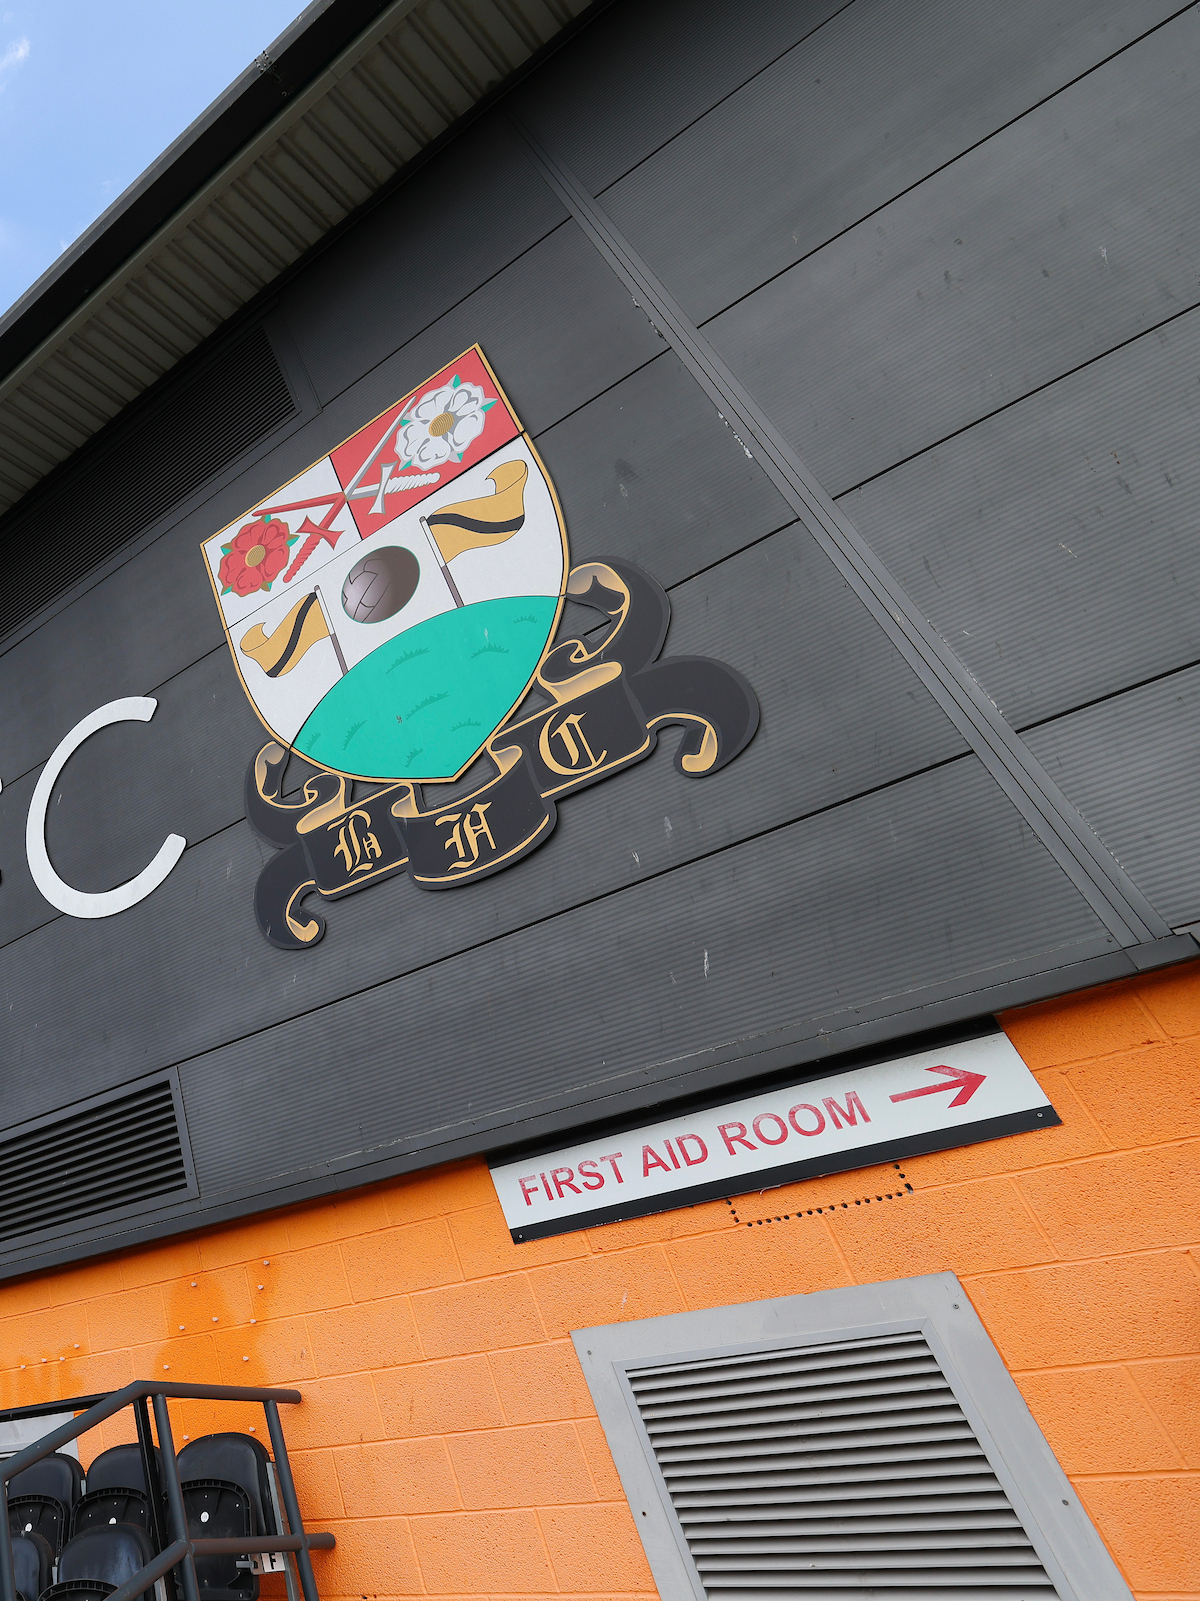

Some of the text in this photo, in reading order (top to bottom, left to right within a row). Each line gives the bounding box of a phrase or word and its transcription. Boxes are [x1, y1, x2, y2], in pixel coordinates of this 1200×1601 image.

[518, 1089, 872, 1207] FIRST AID ROOM
